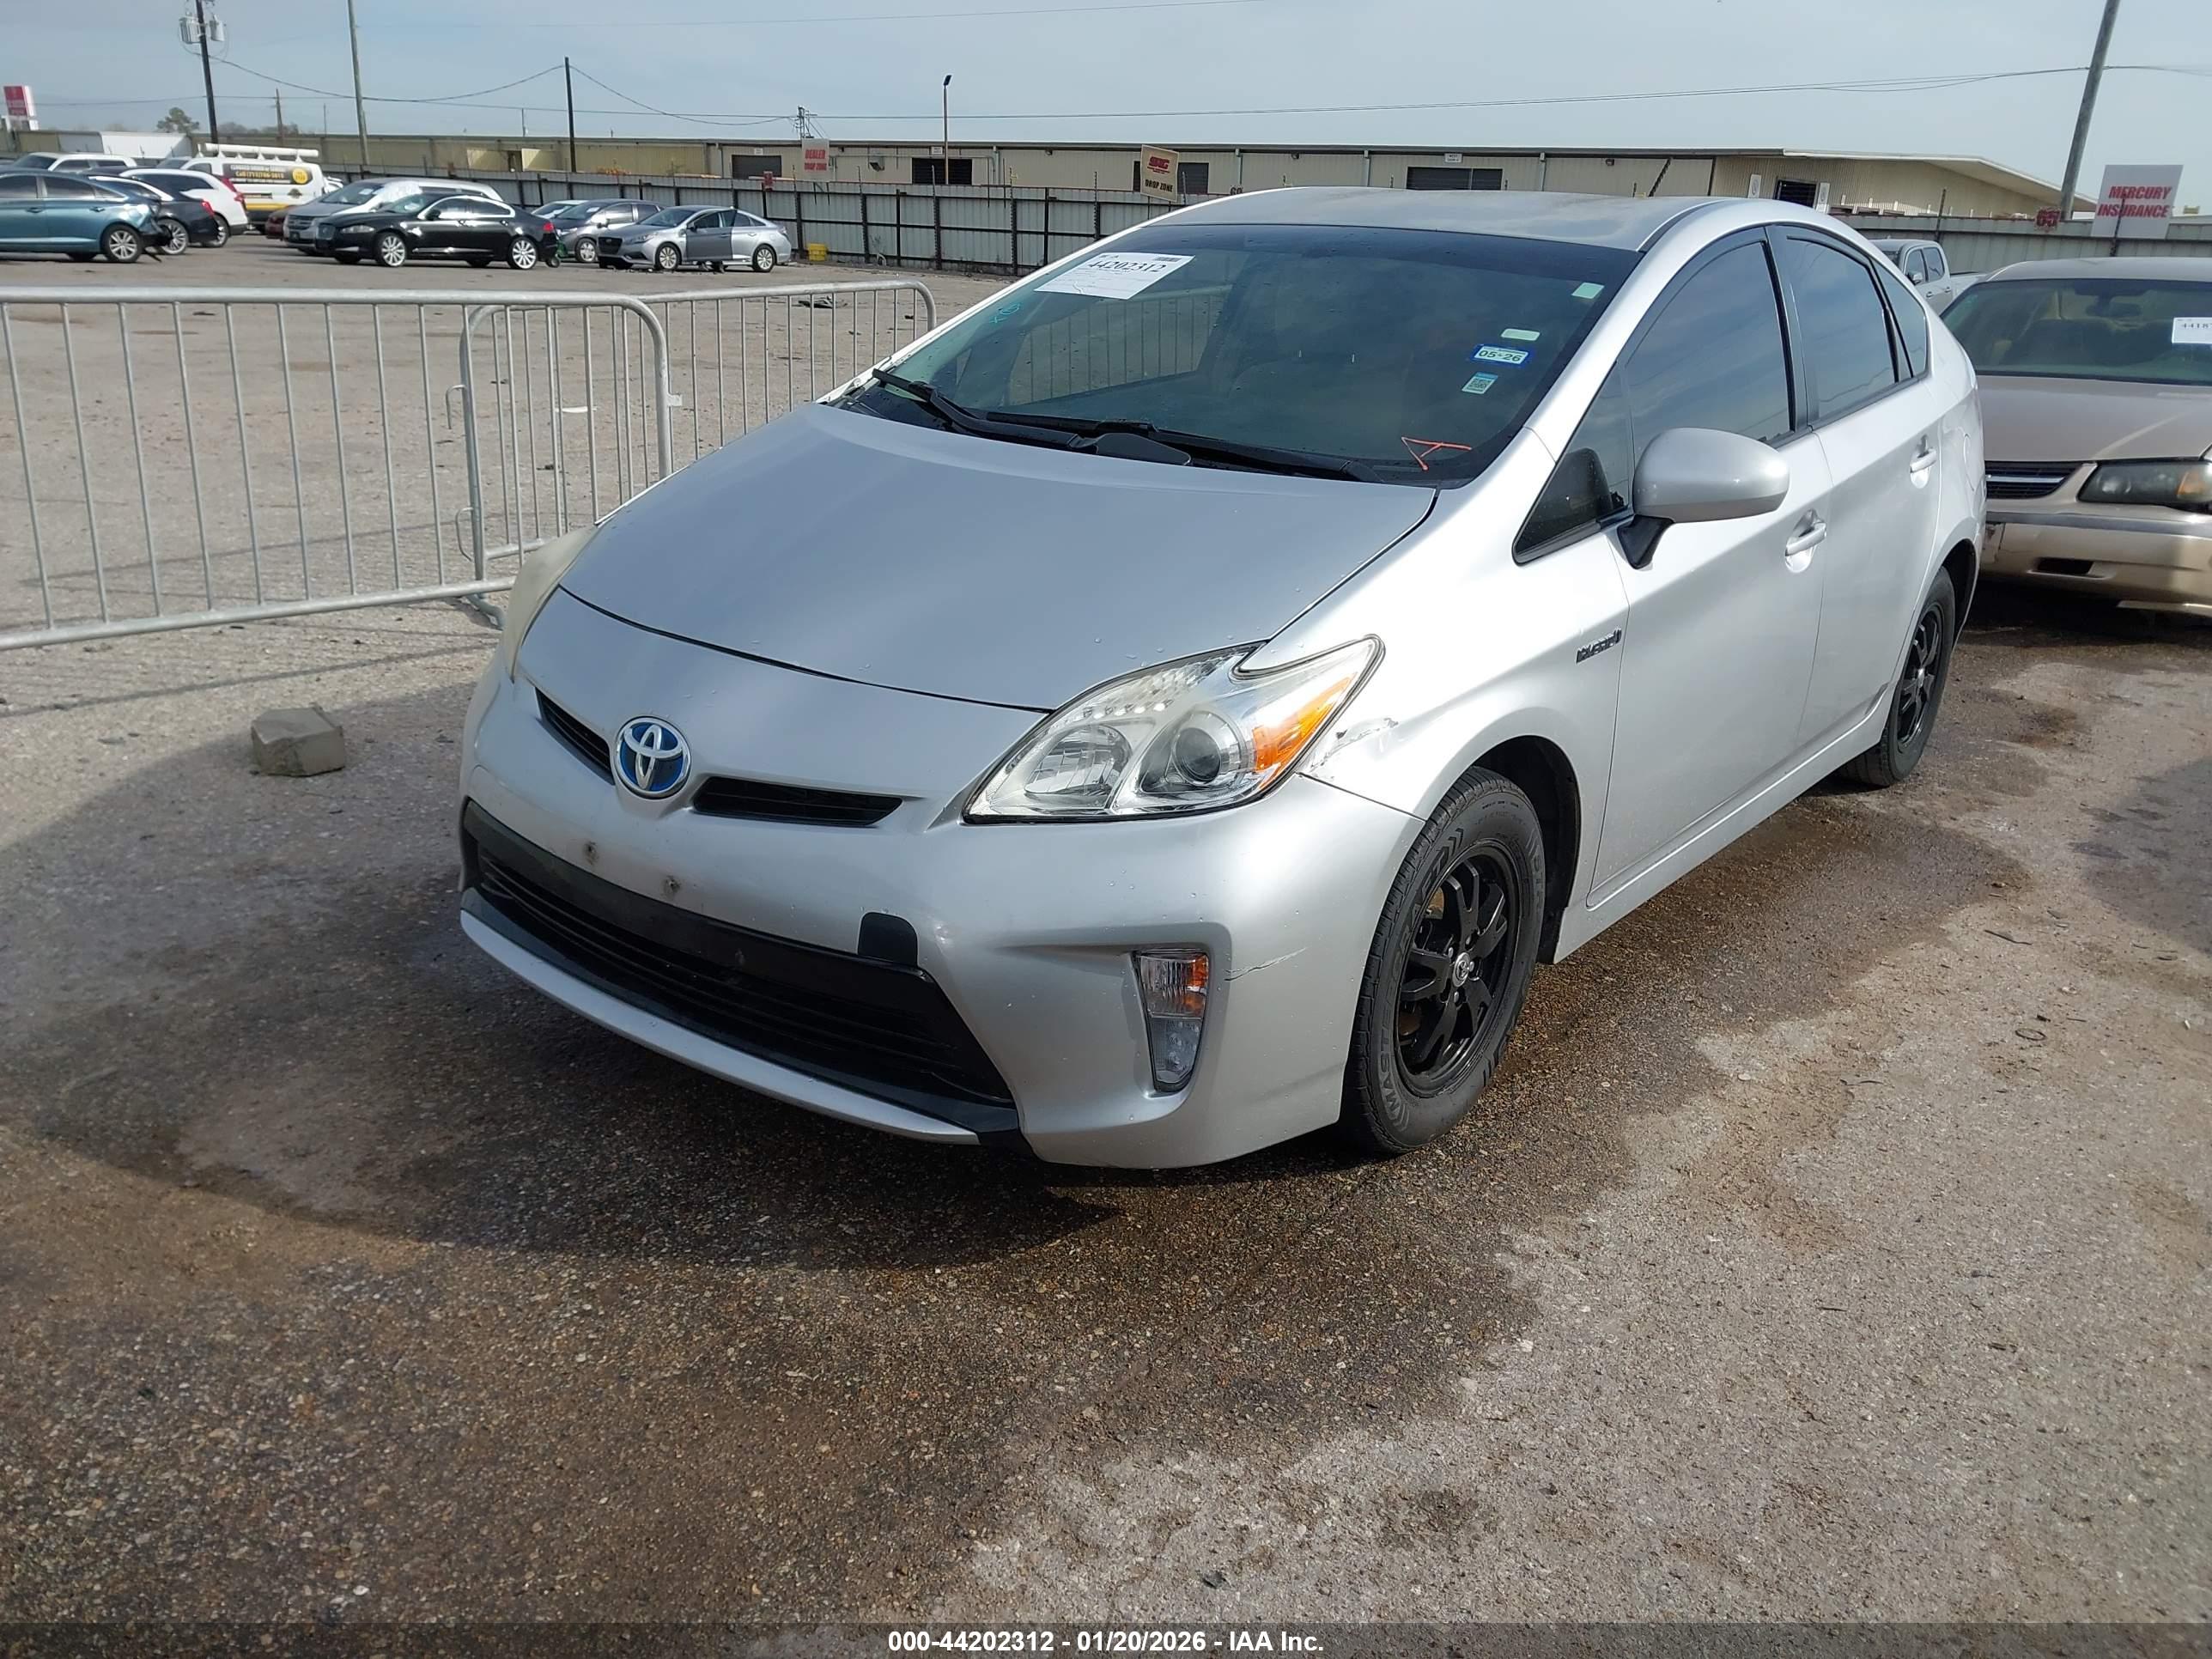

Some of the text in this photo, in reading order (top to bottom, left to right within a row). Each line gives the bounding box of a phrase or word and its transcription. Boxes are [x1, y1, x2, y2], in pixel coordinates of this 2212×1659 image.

[1145, 179, 1173, 192] DROP ZONE
[2108, 185, 2172, 200] MERCURY
[2097, 204, 2170, 218] INSURANCE
[1088, 260, 1167, 272] 44202312
